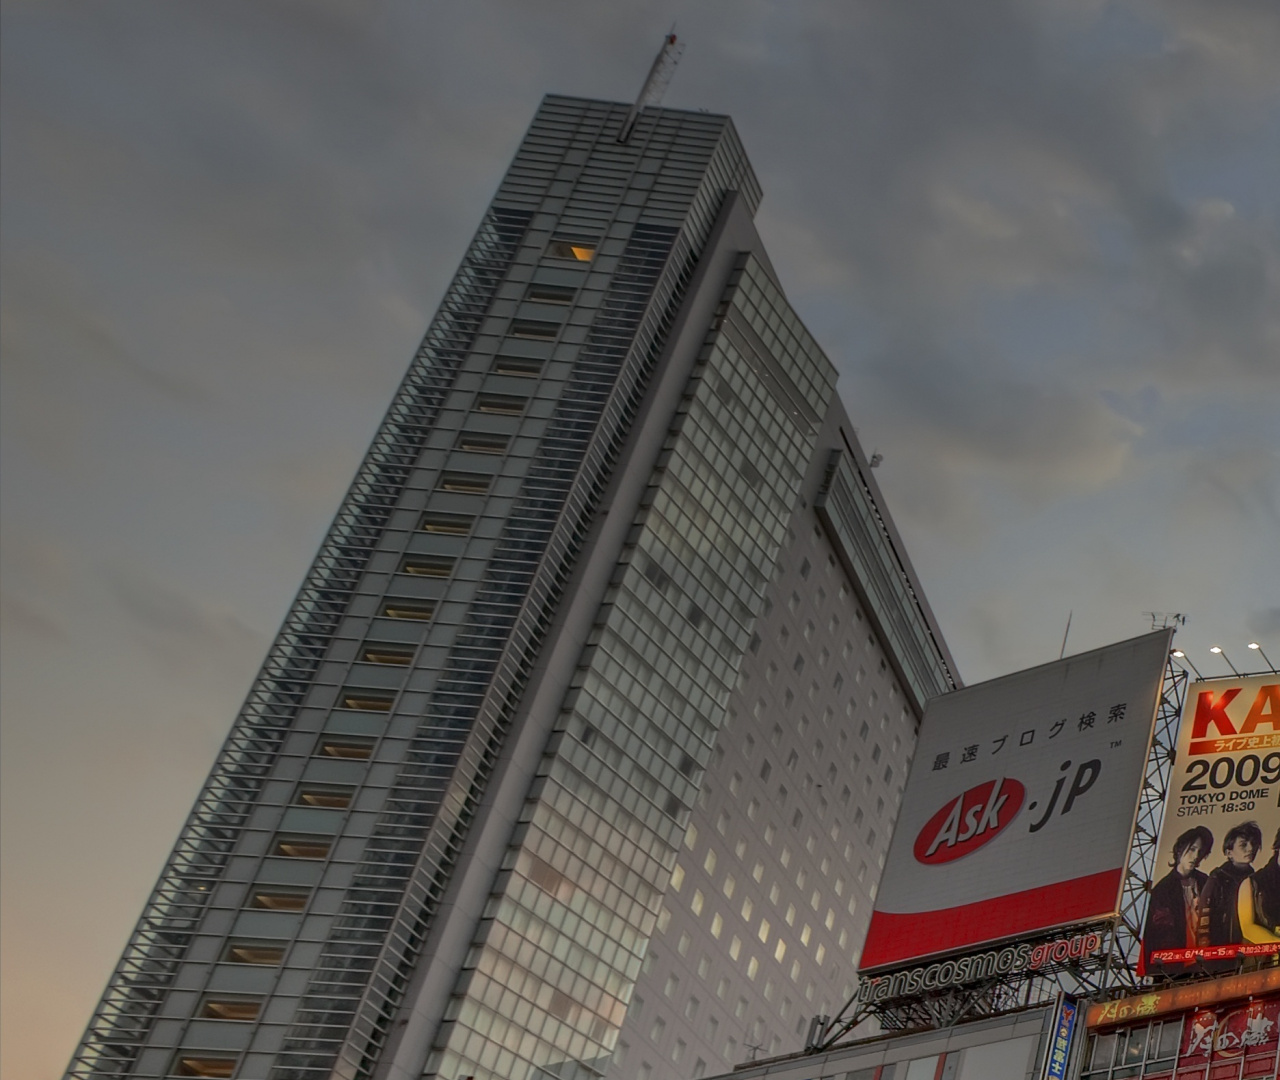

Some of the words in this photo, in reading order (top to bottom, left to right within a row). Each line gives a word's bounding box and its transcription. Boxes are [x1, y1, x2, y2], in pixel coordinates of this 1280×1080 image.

[932, 703, 1127, 772] 最速ブログ検索
[1177, 805, 1217, 817] START
[1220, 801, 1255, 813] 18:30
[1180, 791, 1226, 805] TOKYO
[1229, 788, 1269, 801] DOME
[859, 942, 1031, 1000] transcosmos
[1031, 933, 1099, 970] group
